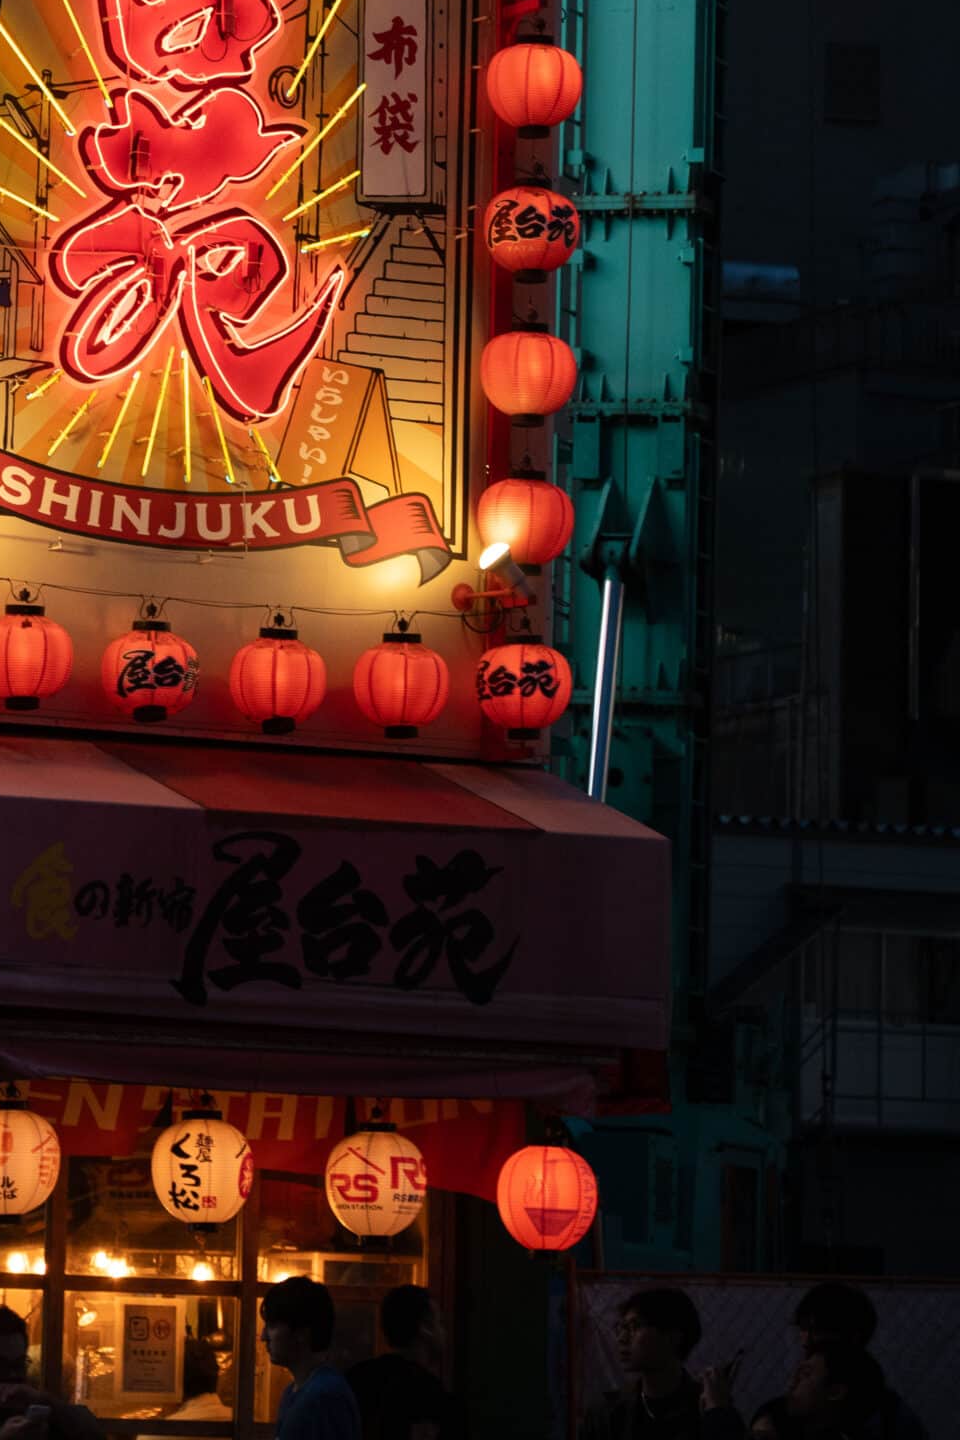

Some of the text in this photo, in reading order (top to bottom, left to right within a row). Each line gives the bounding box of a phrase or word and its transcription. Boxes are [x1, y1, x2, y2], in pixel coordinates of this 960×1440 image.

[168, 1132, 201, 1212] くろ松
[329, 1173, 379, 1203] RS
